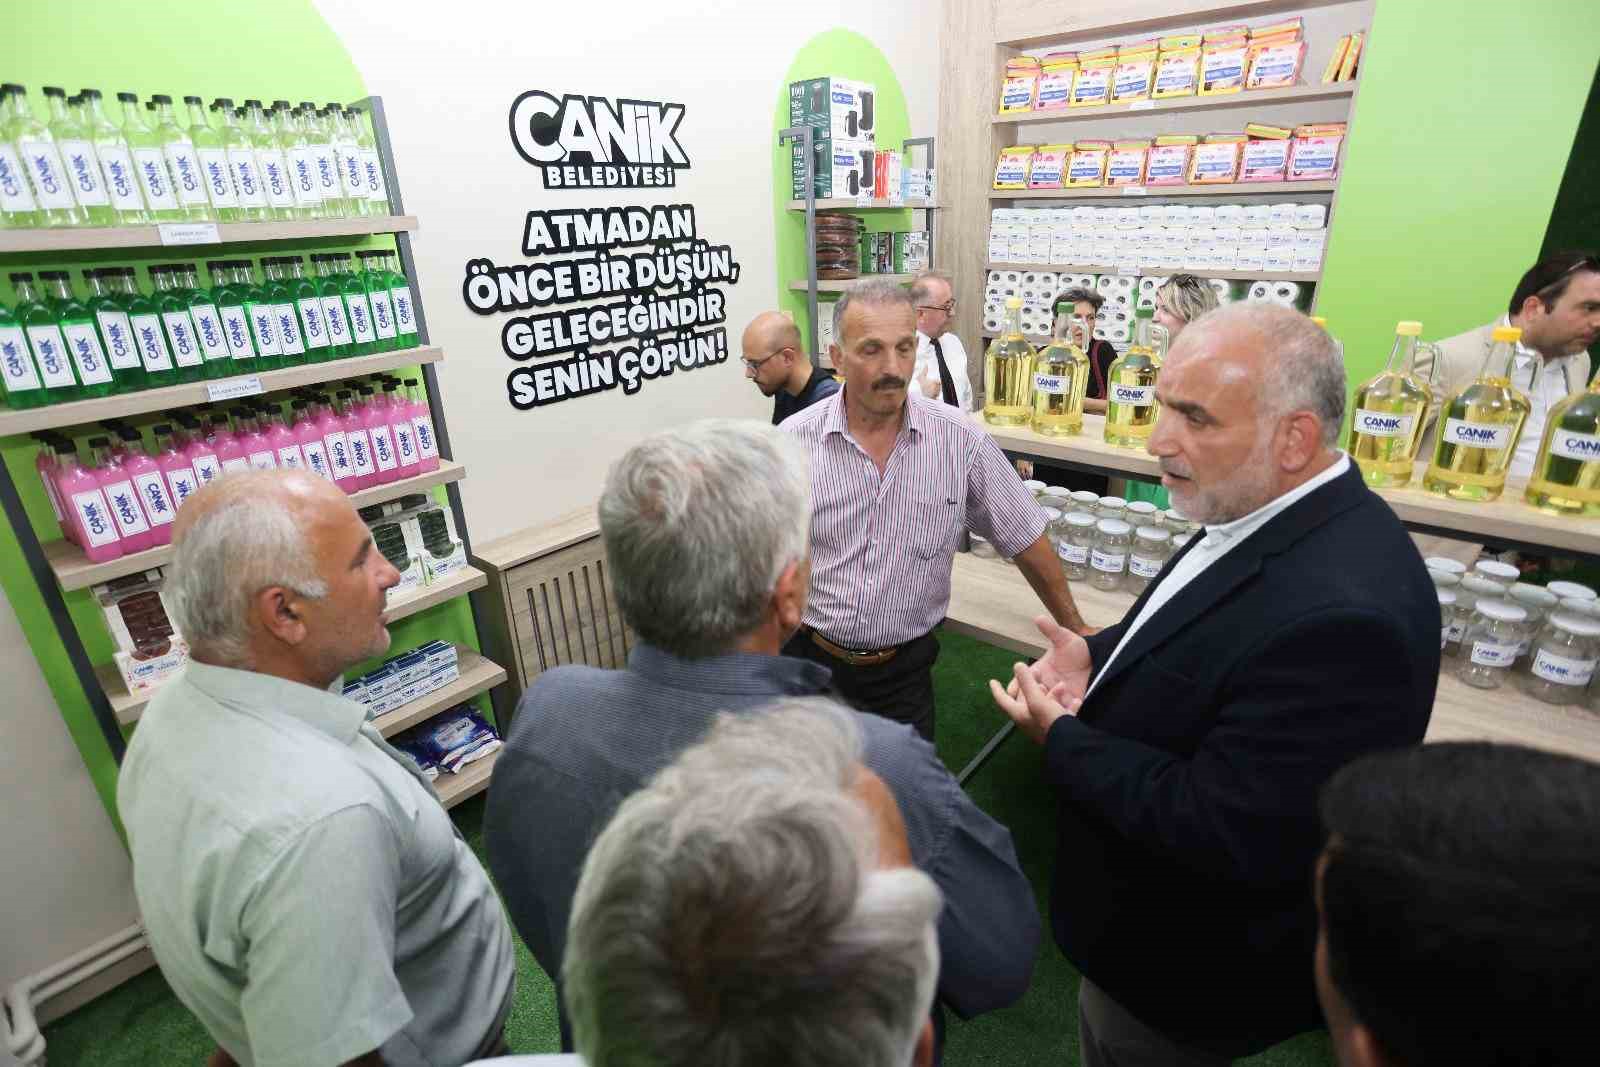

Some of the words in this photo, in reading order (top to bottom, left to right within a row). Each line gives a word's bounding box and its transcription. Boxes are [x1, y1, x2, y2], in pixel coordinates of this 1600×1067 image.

[527, 206, 692, 250] ATMADAN
[468, 264, 573, 309] ÖNCE
[578, 252, 632, 294] BİR
[635, 243, 738, 289] DÜŞÜN,
[506, 287, 723, 356] GELECEĞİNDİR
[512, 352, 613, 405] SENİN
[618, 331, 725, 390] ÇÖPÜN!
[1566, 439, 1600, 451] CAN
